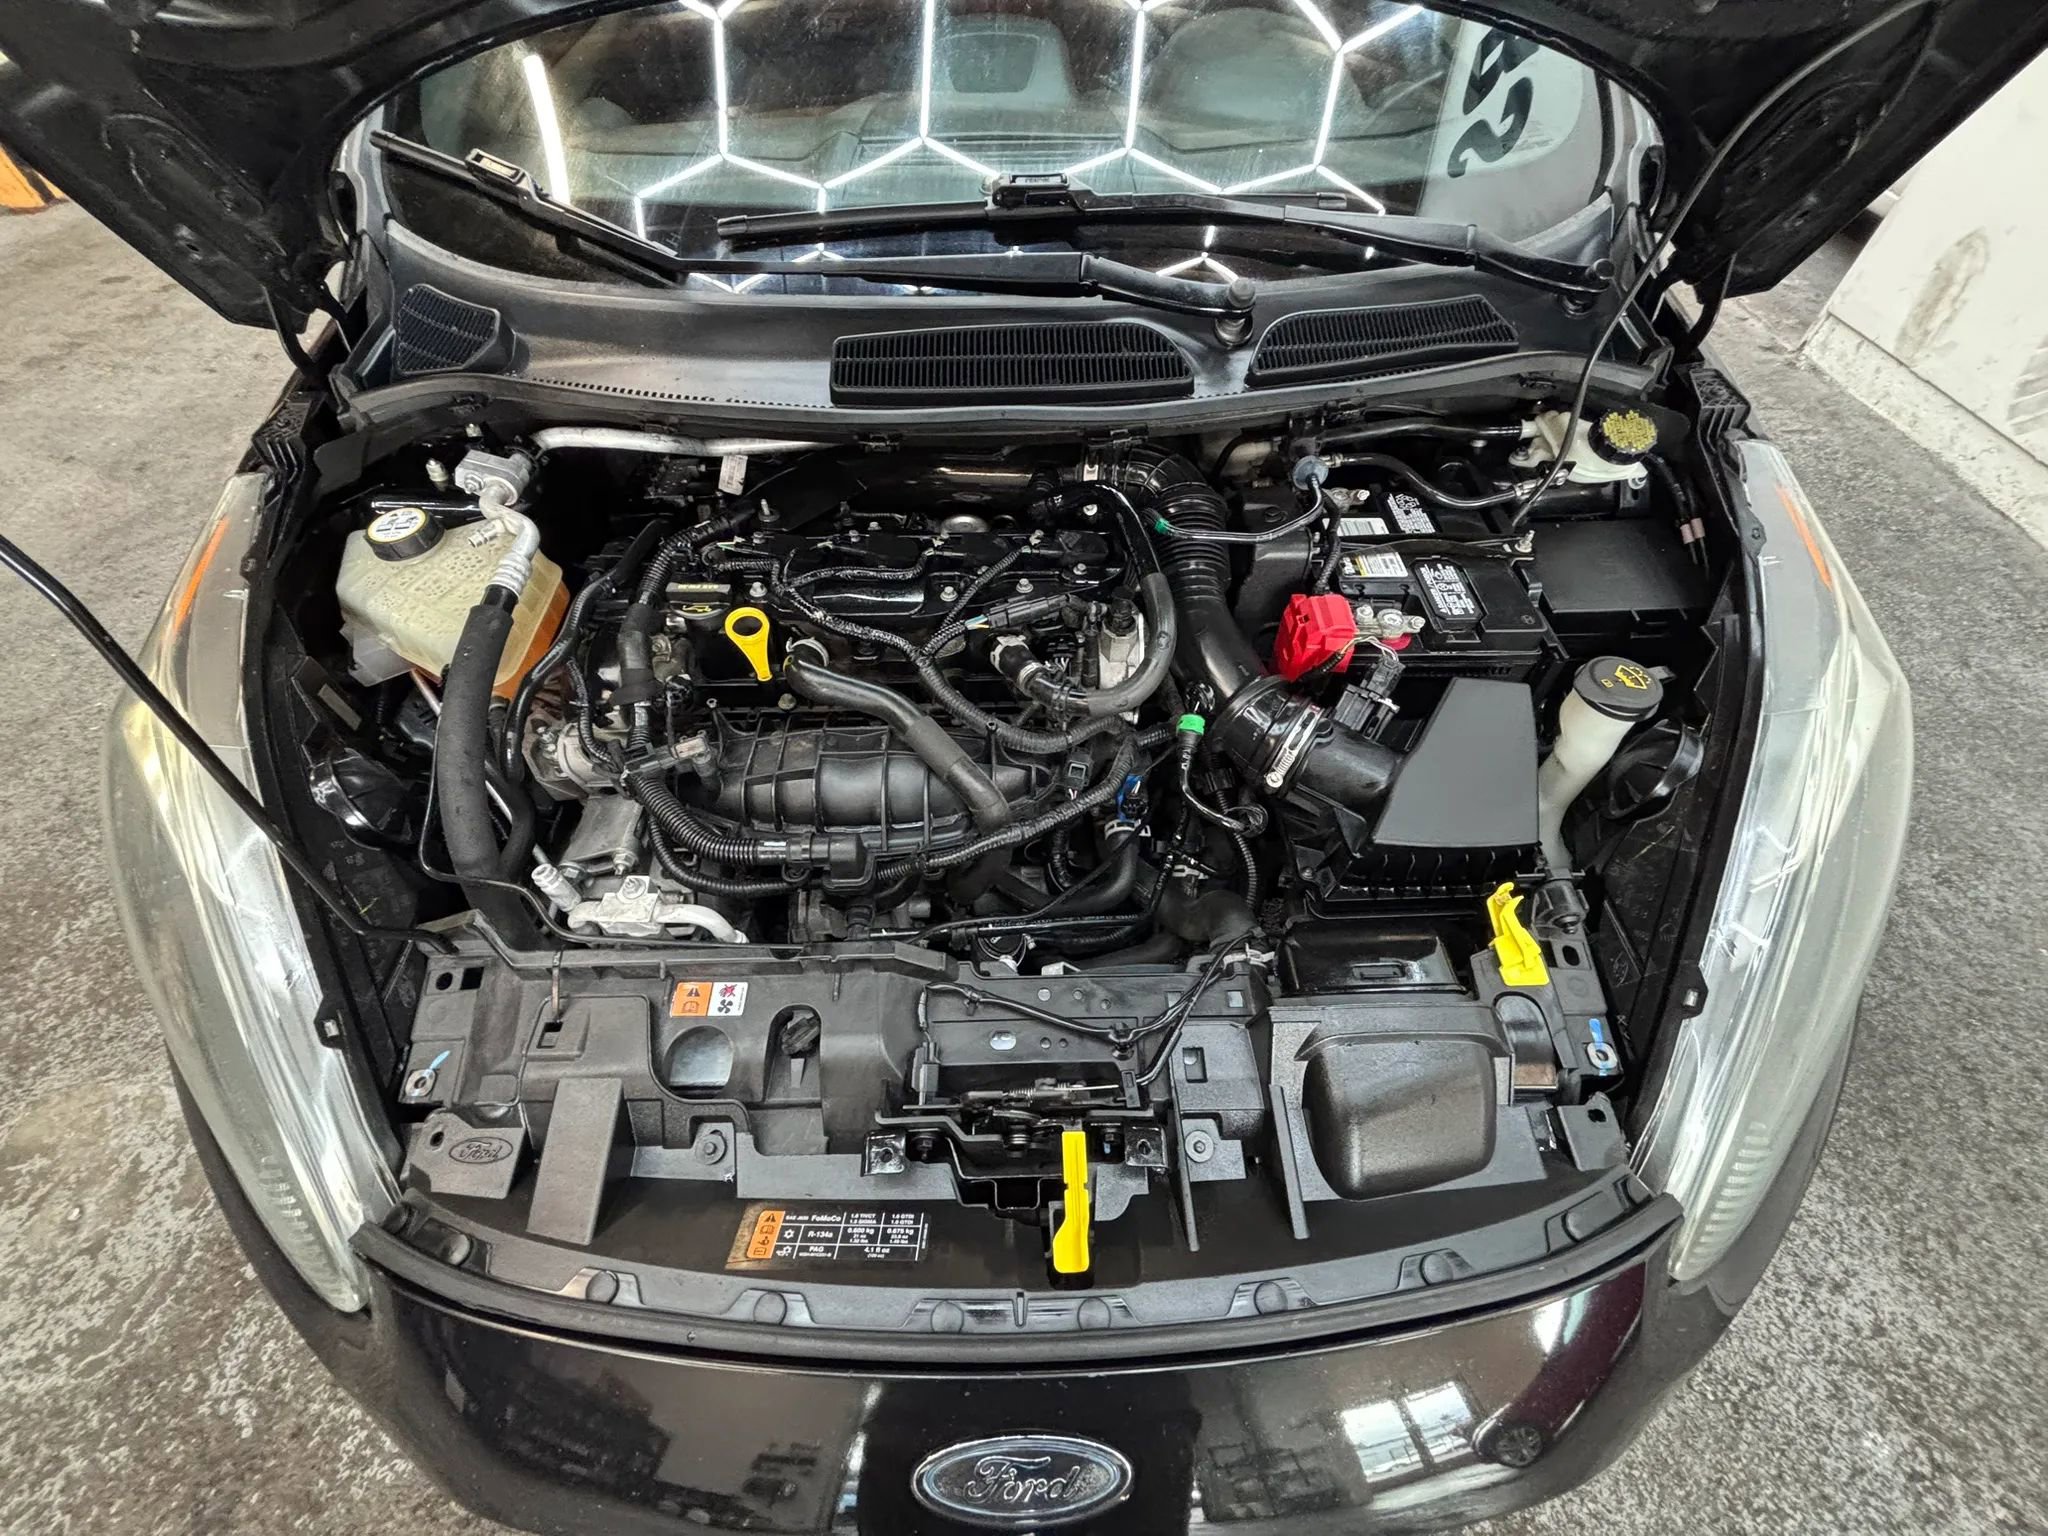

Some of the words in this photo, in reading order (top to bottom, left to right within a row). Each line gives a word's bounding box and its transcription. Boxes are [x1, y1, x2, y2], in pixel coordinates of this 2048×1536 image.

[459, 1140, 503, 1160] Ford
[811, 1214, 841, 1222] FoMoCo
[866, 1227, 875, 1235] kg
[963, 1455, 1081, 1504] Ford
